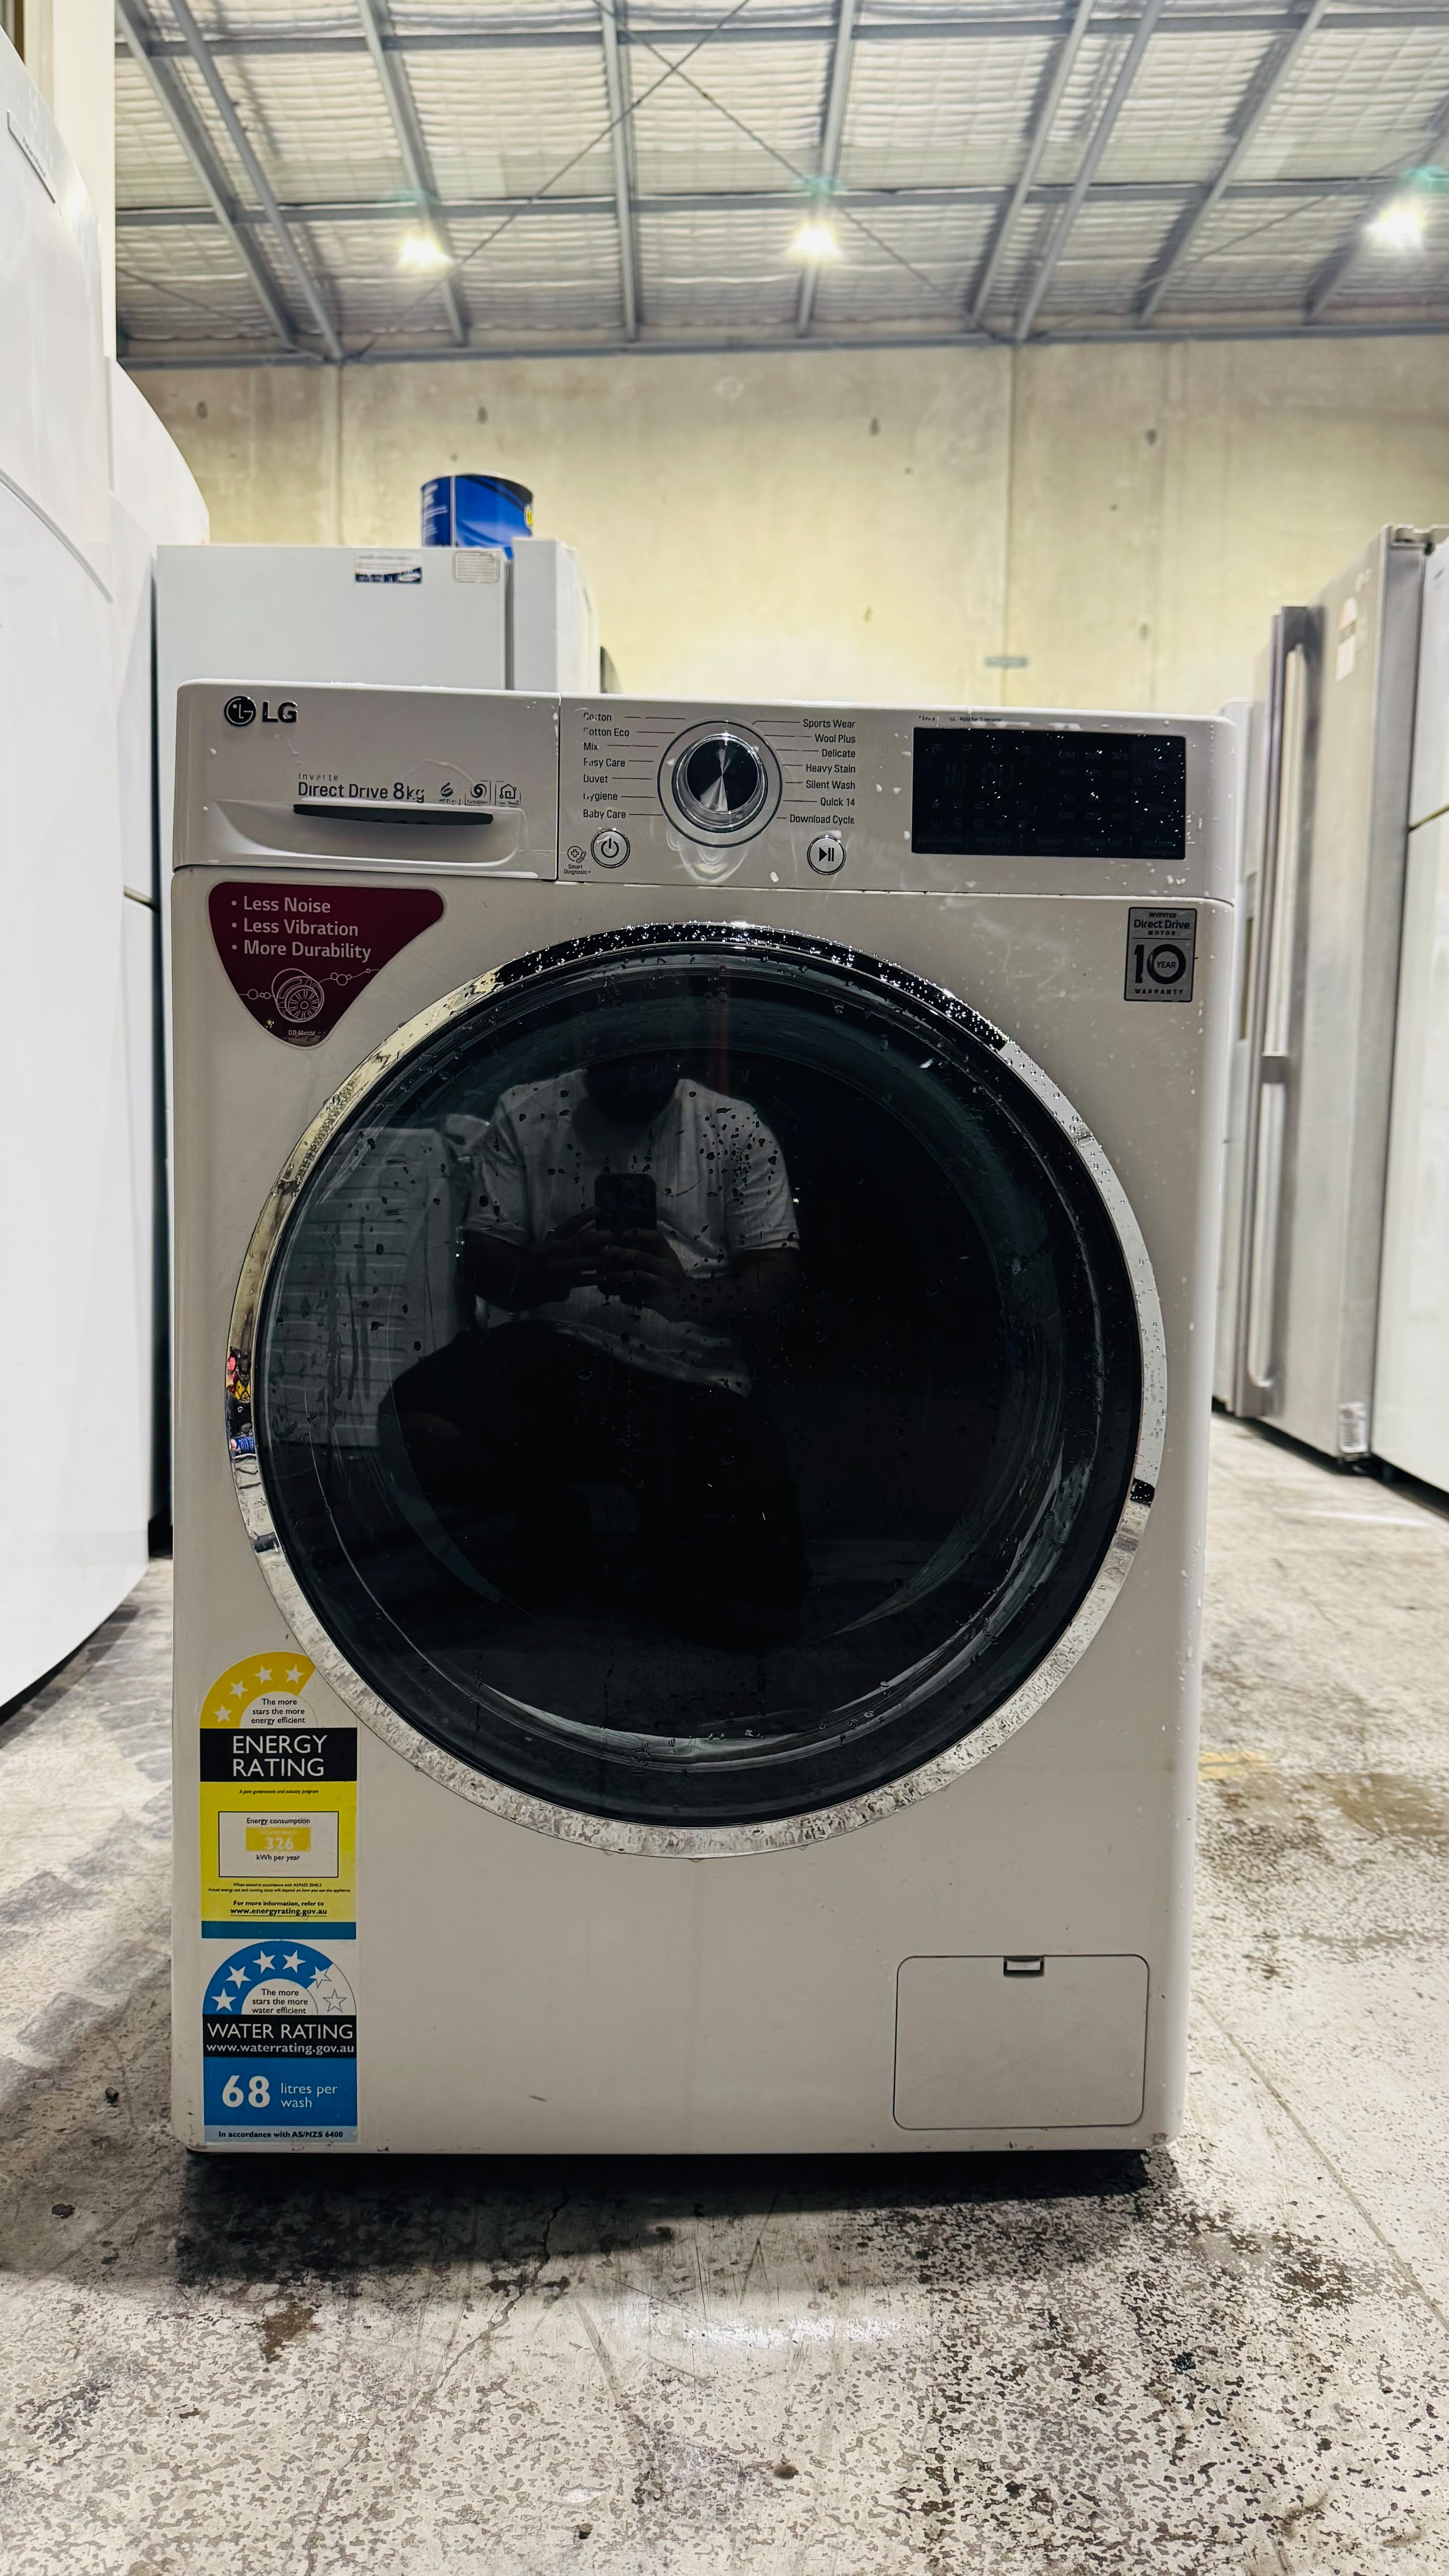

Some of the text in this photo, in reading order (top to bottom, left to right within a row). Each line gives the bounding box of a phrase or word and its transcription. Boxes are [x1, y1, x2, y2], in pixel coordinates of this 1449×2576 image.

[262, 701, 298, 723] LG
[803, 719, 855, 729] Sports Wear
[614, 728, 629, 737] Eco
[815, 734, 855, 743] Wool Plus
[584, 742, 598, 751] Mix
[822, 749, 855, 758] Delicate
[584, 758, 625, 768] Easy Care
[806, 763, 855, 774] Heavy Stain
[584, 774, 608, 783] Duvet
[806, 780, 855, 789] Silent Wash
[298, 782, 344, 797] Direct
[349, 783, 388, 799] Drive
[821, 797, 855, 807] Quick 14
[583, 809, 626, 820] Baby Care
[790, 814, 855, 825] Download Cycle
[244, 896, 331, 913] Less Noise
[244, 918, 359, 936] Less Vibration
[1134, 919, 1190, 929] Direct Drive
[244, 940, 371, 962] More Durability
[1134, 944, 1186, 985] 10
[233, 1735, 328, 1754] ENERGY
[233, 1758, 325, 1777] RATING
[265, 1836, 294, 1850] 326
[230, 1907, 328, 1916] www.energyrating.gov.au
[261, 1988, 276, 1996] The
[207, 2023, 353, 2039] WATER RATING
[206, 2043, 354, 2055] www.waterrating.gov.au
[222, 2075, 338, 2108] 68 litres per
[281, 2097, 312, 2108] wash
